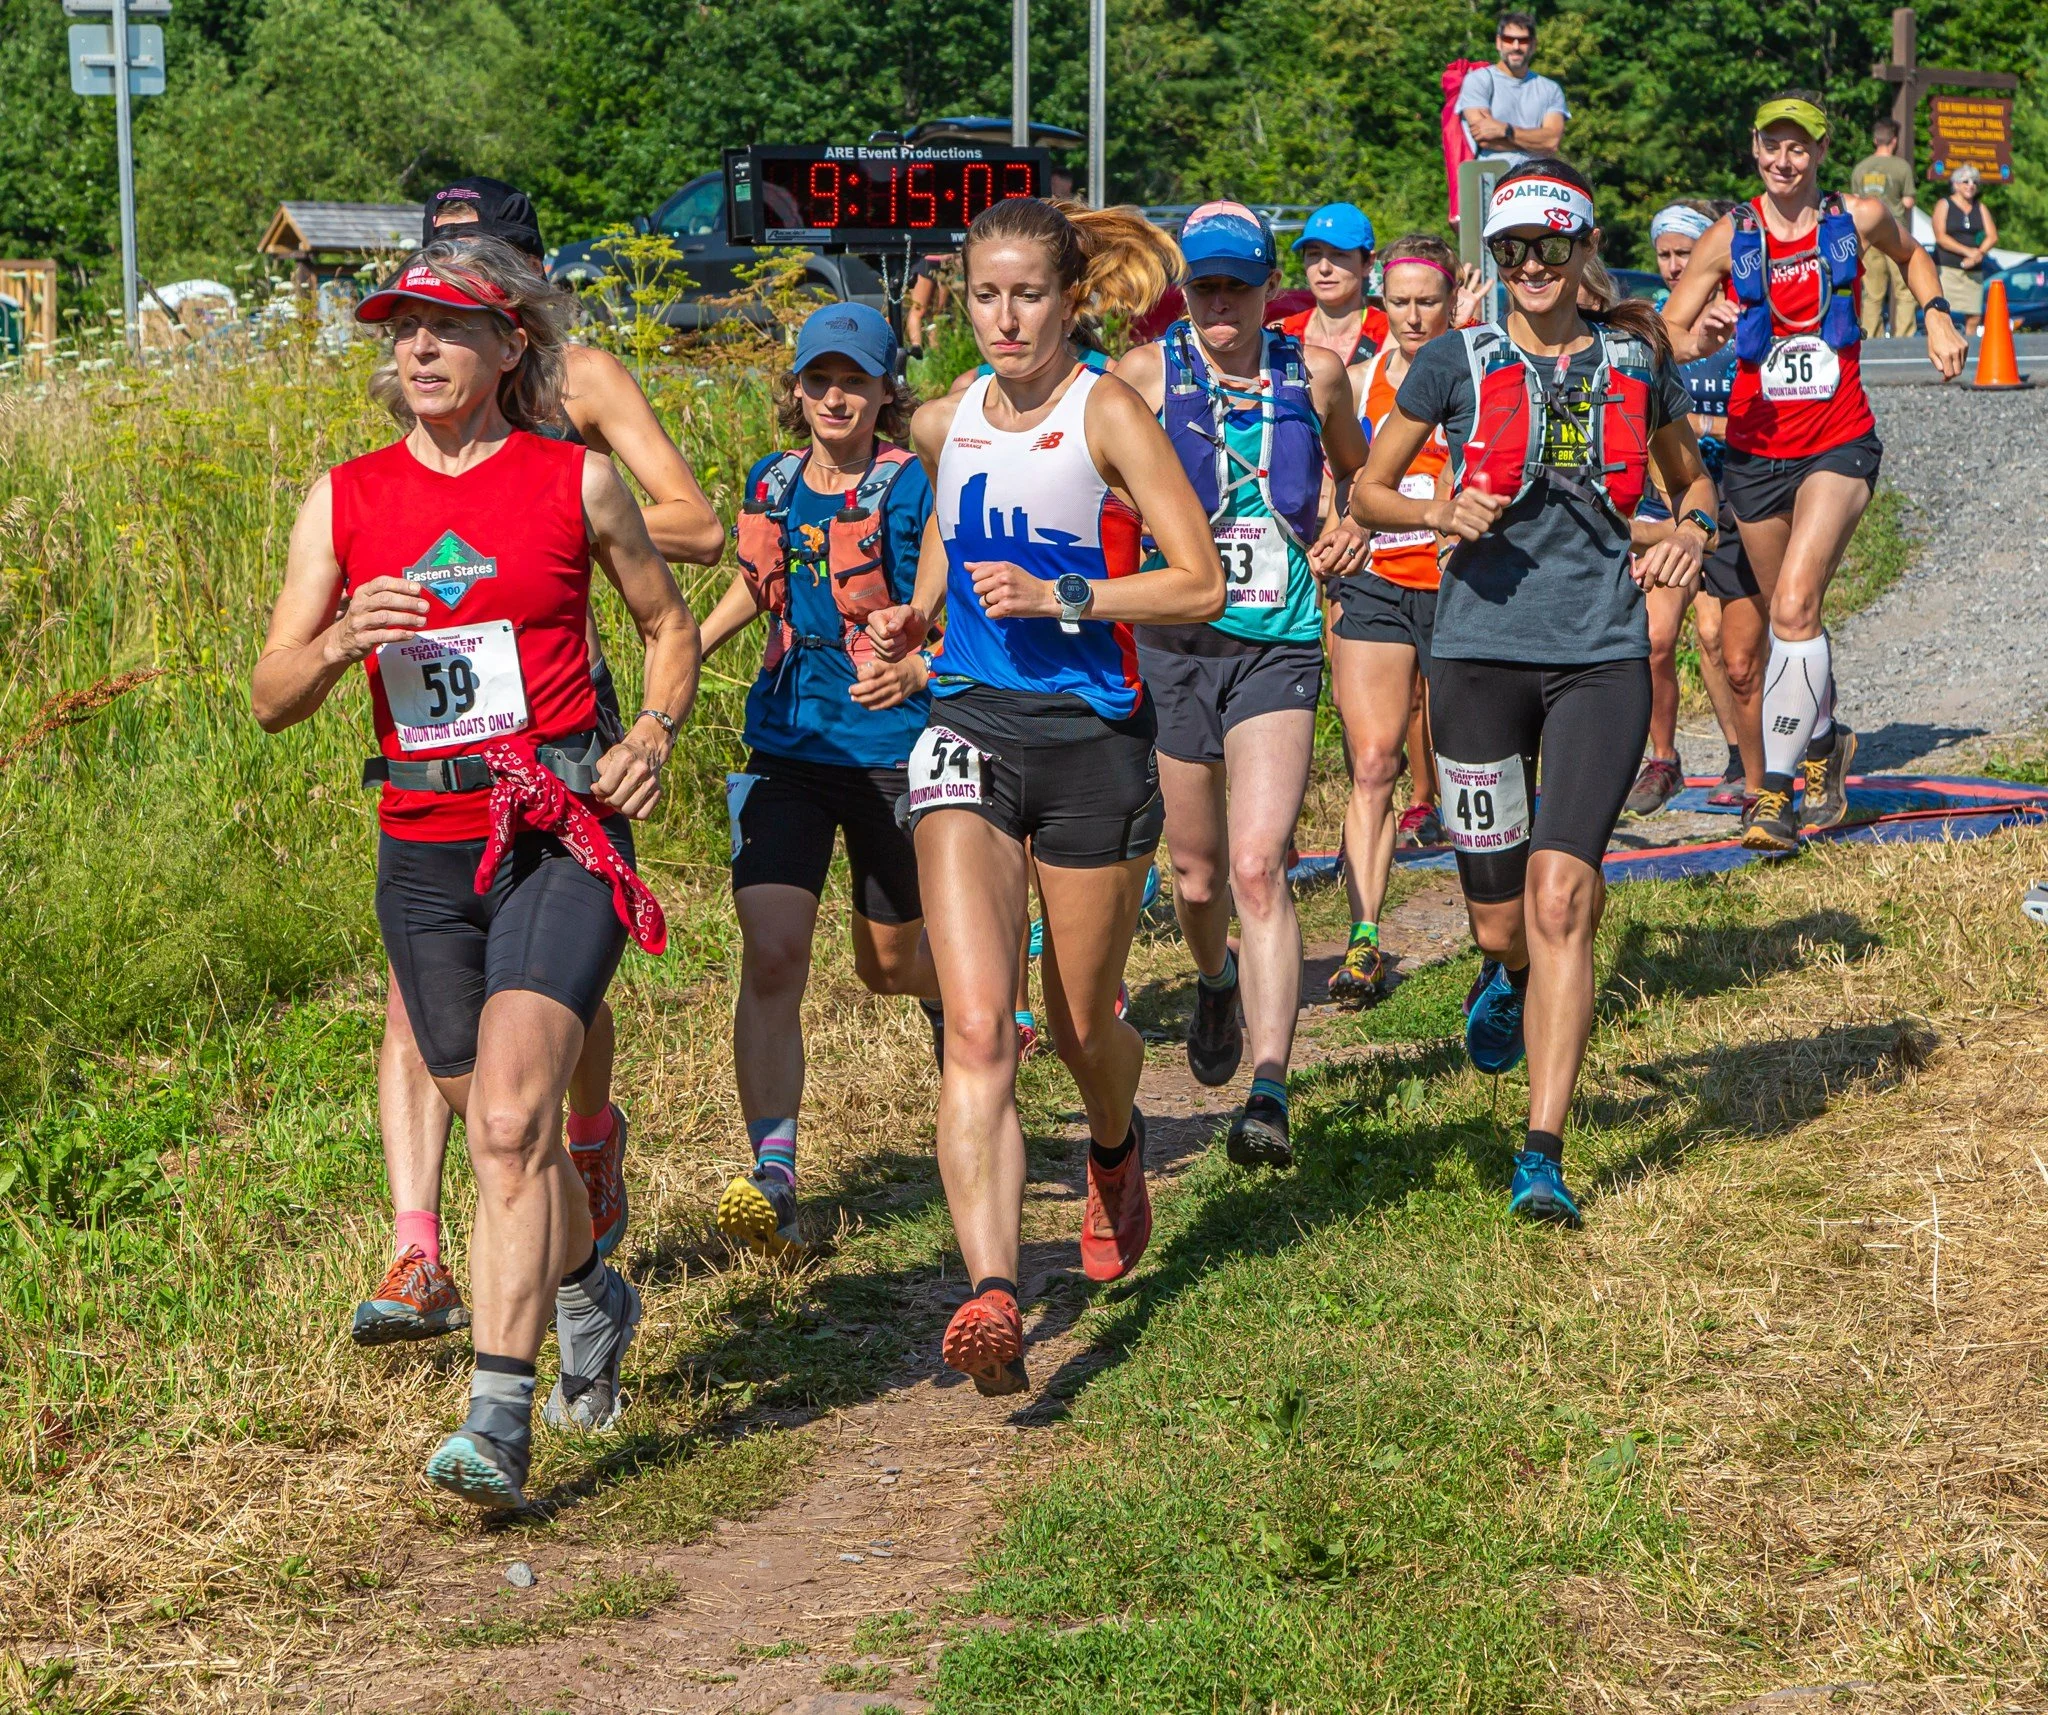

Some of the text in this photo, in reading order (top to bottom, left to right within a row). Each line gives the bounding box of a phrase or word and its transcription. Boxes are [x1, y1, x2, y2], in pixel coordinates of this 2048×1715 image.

[824, 147, 983, 160] ARE Event Productions
[1784, 353, 1813, 384] 56
[1690, 378, 1731, 392] THE
[1768, 384, 1834, 396] MOUNTAIN GOATS ONLY
[406, 563, 493, 582] Eastern States
[1216, 542, 1254, 585] 53
[443, 586, 461, 596] 100
[1230, 589, 1280, 602] GOATS ONLY
[400, 636, 485, 656] ESCARPMENT
[411, 645, 477, 661] TRAIL RUN
[421, 659, 476, 718] 59
[403, 711, 515, 744] MOUNTAIN GOATS ONLY
[930, 736, 972, 780] 54
[1445, 768, 1504, 781] ESCARPMENT
[1450, 776, 1497, 787] TRAIL RUN
[909, 783, 976, 806] MOUNTAIN GOATS
[1456, 788, 1495, 831] 49
[1475, 832, 1503, 848] GOATS
[1503, 825, 1522, 843] ONLY
